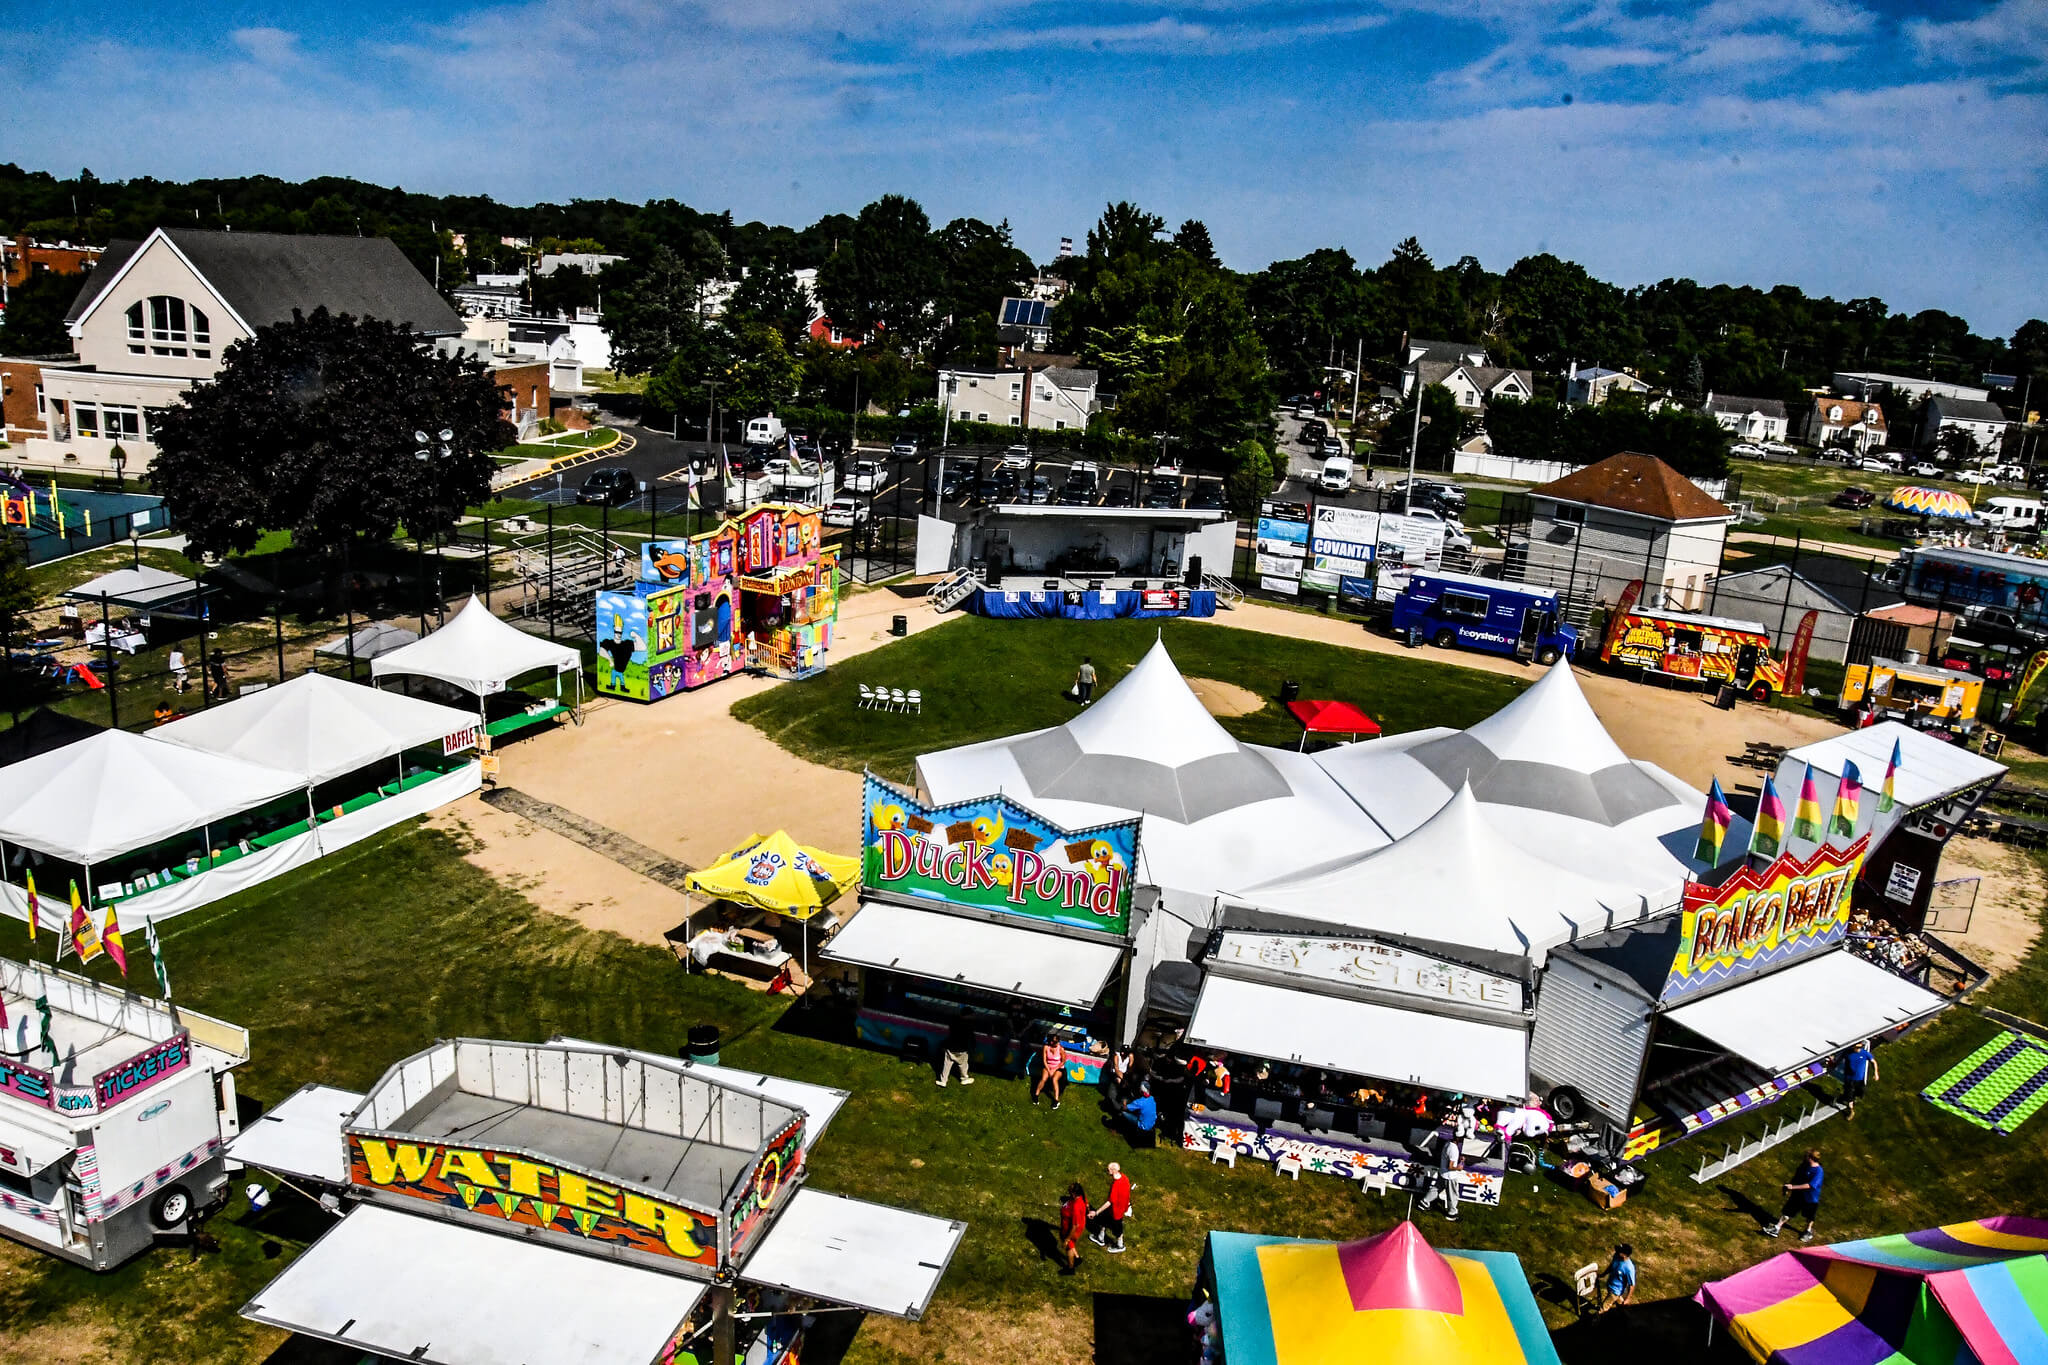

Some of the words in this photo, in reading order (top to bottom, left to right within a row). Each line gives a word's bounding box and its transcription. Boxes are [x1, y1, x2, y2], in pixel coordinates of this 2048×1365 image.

[1314, 538, 1371, 560] COVANTA
[445, 727, 474, 752] RAFFLE
[750, 850, 787, 868] KNOT
[878, 830, 998, 890] Duck
[1006, 847, 1121, 917] Pond
[1342, 942, 1403, 958] PATTIE'S
[1689, 893, 1783, 968] BONGO
[1353, 955, 1510, 1006] STORE
[103, 1045, 183, 1099] TICKETS
[58, 1095, 93, 1110] ATM
[357, 1137, 705, 1259] WATER
[1330, 1160, 1479, 1201] STOE
[464, 1184, 594, 1233] GAME
